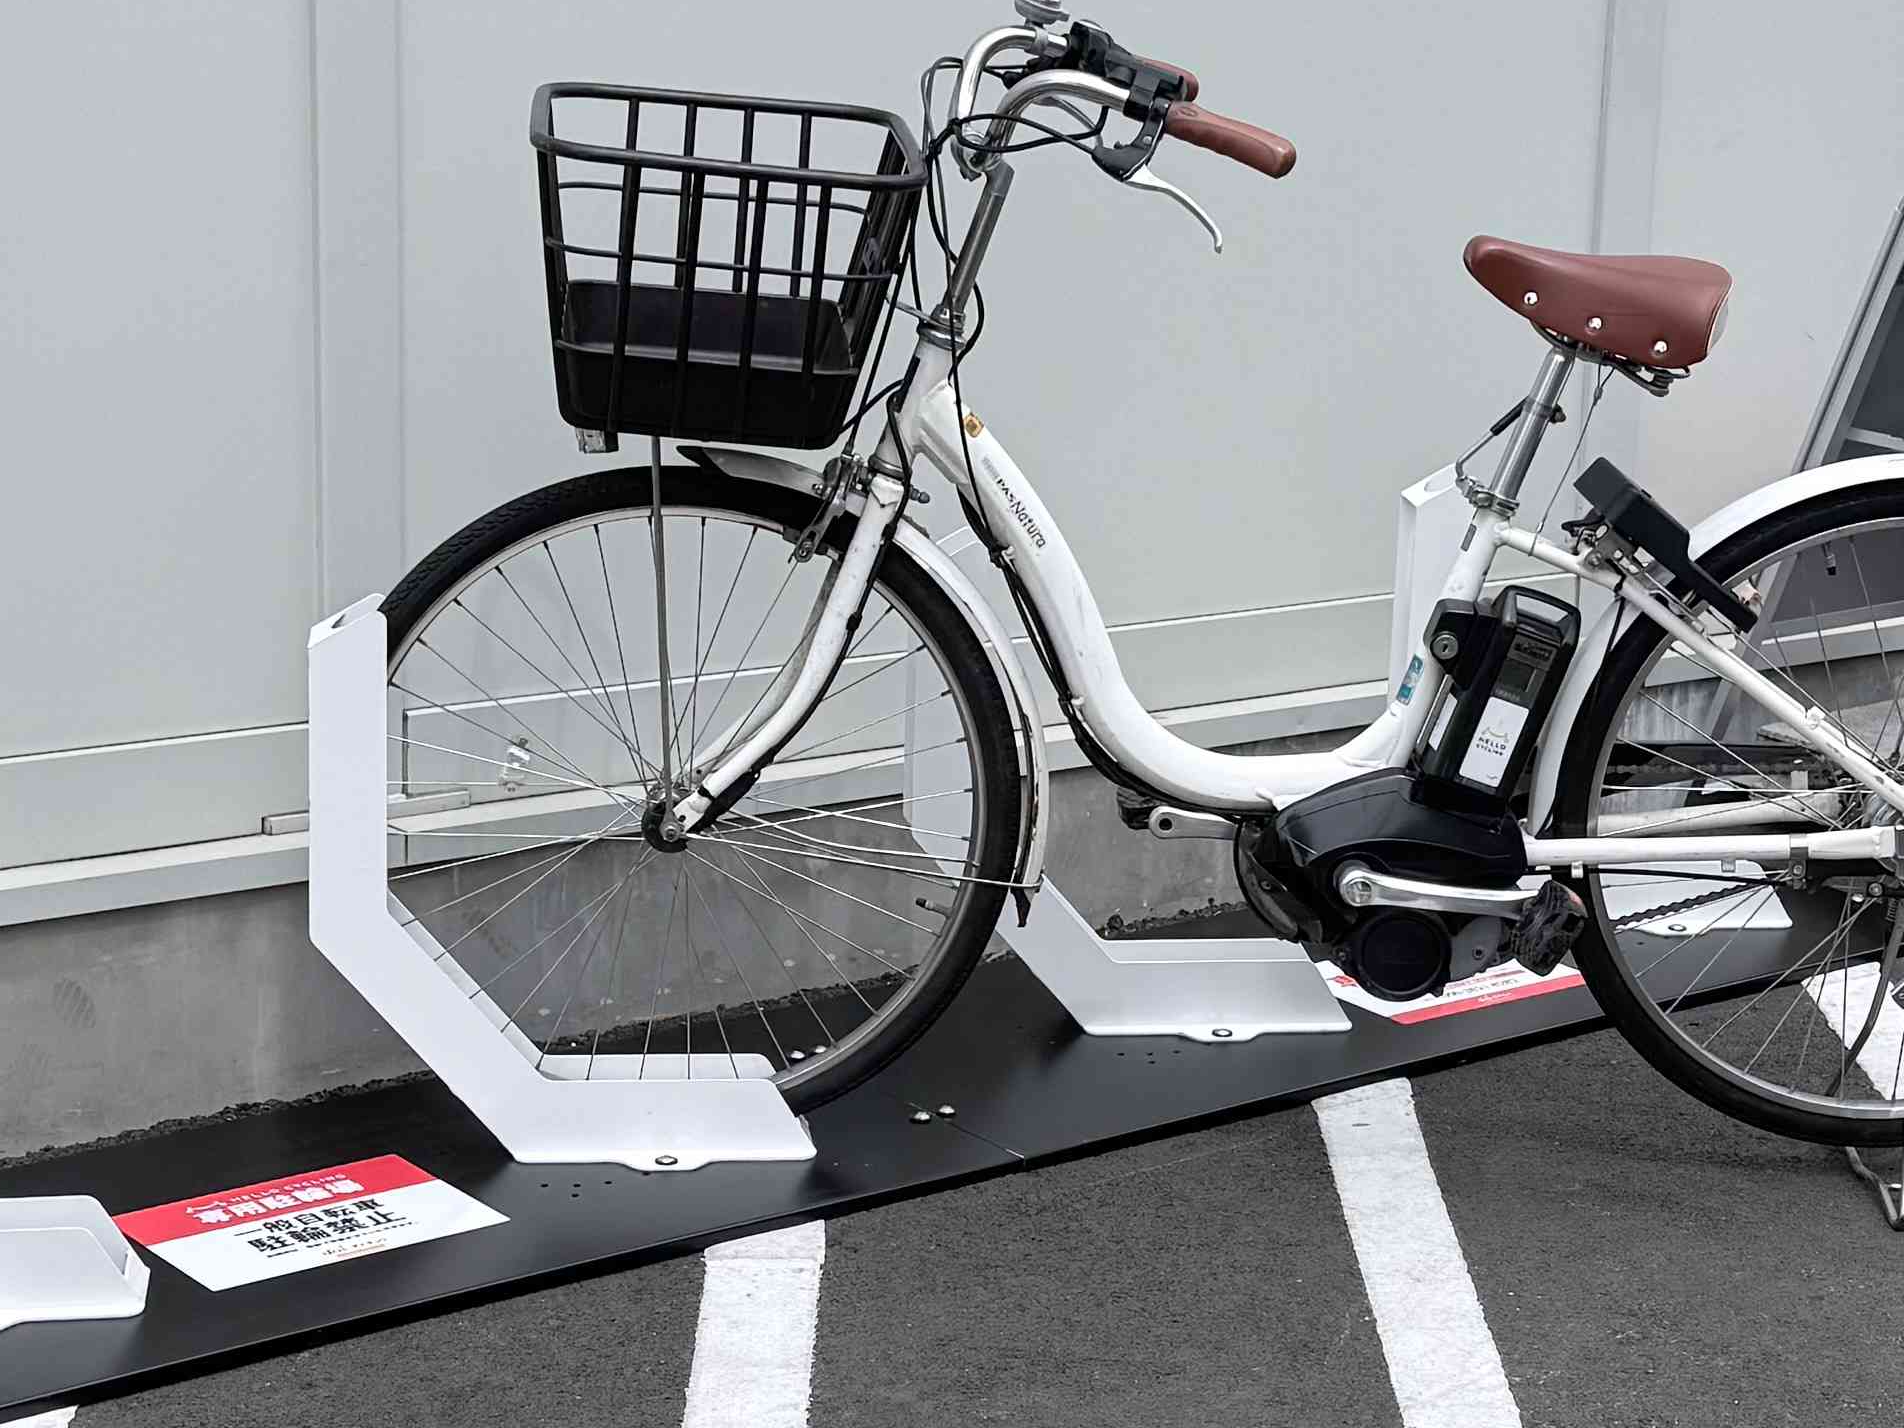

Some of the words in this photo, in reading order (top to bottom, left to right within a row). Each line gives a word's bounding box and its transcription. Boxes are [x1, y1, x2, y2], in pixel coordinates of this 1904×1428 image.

[996, 478, 1014, 502] PAS
[1010, 500, 1046, 549] Natura
[233, 1198, 384, 1237] 一般自転車
[247, 1210, 408, 1253] 駐輪禁止
